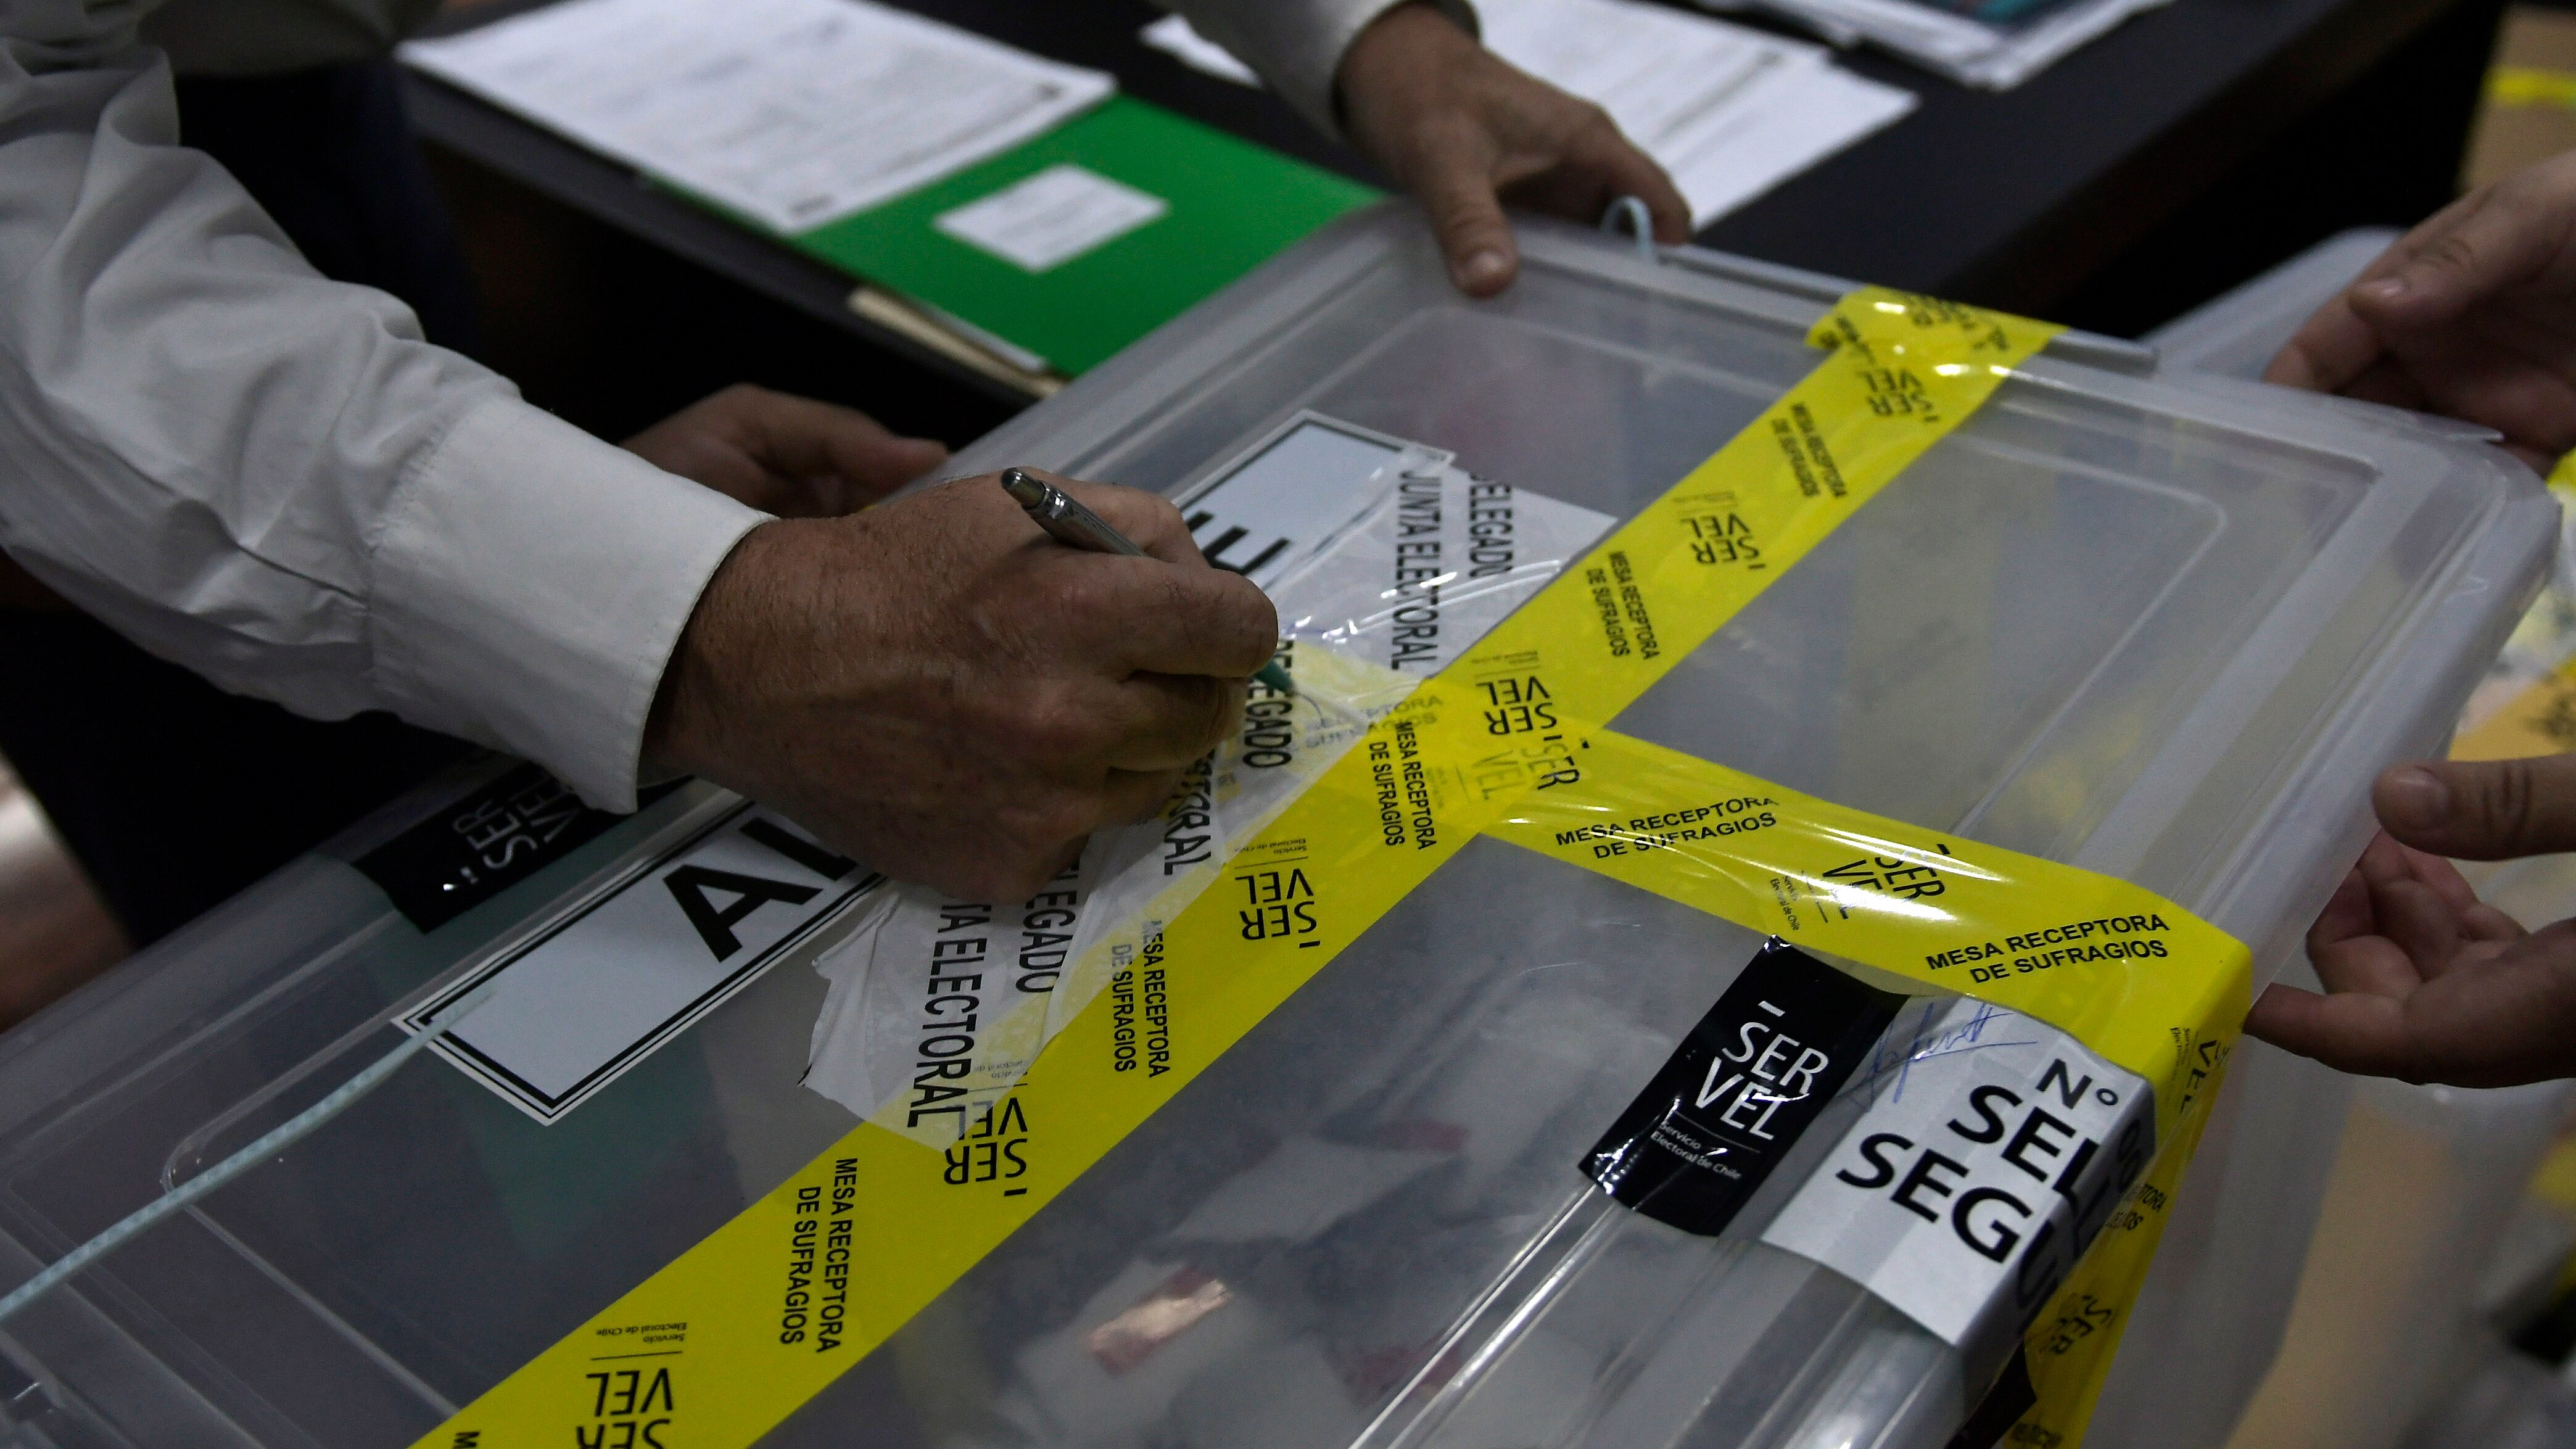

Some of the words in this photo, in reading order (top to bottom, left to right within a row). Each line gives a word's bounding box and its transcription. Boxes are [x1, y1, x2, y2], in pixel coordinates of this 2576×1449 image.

[1680, 513, 1749, 539] VEL
[1690, 535, 1759, 564] SER
[1592, 586, 1630, 657] SUFRAGIOS
[1620, 585, 1660, 659] RECEPTORA
[1476, 676, 1550, 706] VEL
[1395, 721, 1418, 760] MESA
[1484, 703, 1557, 735] SER
[1369, 741, 1390, 761] DE
[1372, 764, 1406, 846] SUFRAGIOS
[1402, 761, 1437, 850] RECEPTORA
[1555, 824, 1625, 846] MESA
[1630, 796, 1780, 832] RECEPTORA
[1593, 841, 1627, 859] DE
[1633, 812, 1777, 851] SUFRAGIOS
[1235, 869, 1314, 904] VEL
[1142, 920, 1165, 968] MESA
[1239, 901, 1317, 940] SER
[1925, 942, 2004, 970] MESA
[2005, 914, 2170, 952] RECEPTORA
[1111, 944, 1133, 968] DE
[1970, 963, 2010, 984] DE
[2013, 939, 2168, 973] SUFRAGIOS
[907, 938, 988, 1128] ELECTORAL
[1112, 970, 1137, 1073] SUFRAGIOS
[1144, 970, 1170, 1078] RECEPTORA
[1722, 1022, 1829, 1095] SER
[946, 1097, 1028, 1141] VEL
[1695, 1057, 1787, 1141] VEL
[944, 1138, 1028, 1185] SER
[796, 1186, 821, 1214] DE
[832, 1158, 858, 1215] MESA
[780, 1219, 817, 1345] SUFRAGIOS
[816, 1219, 852, 1353] RECEPTORA
[596, 1327, 622, 1336] Chile
[625, 1326, 638, 1334] de
[641, 1323, 687, 1333] Electoral
[643, 1333, 685, 1343] Servicio
[586, 1367, 674, 1417] VEL
